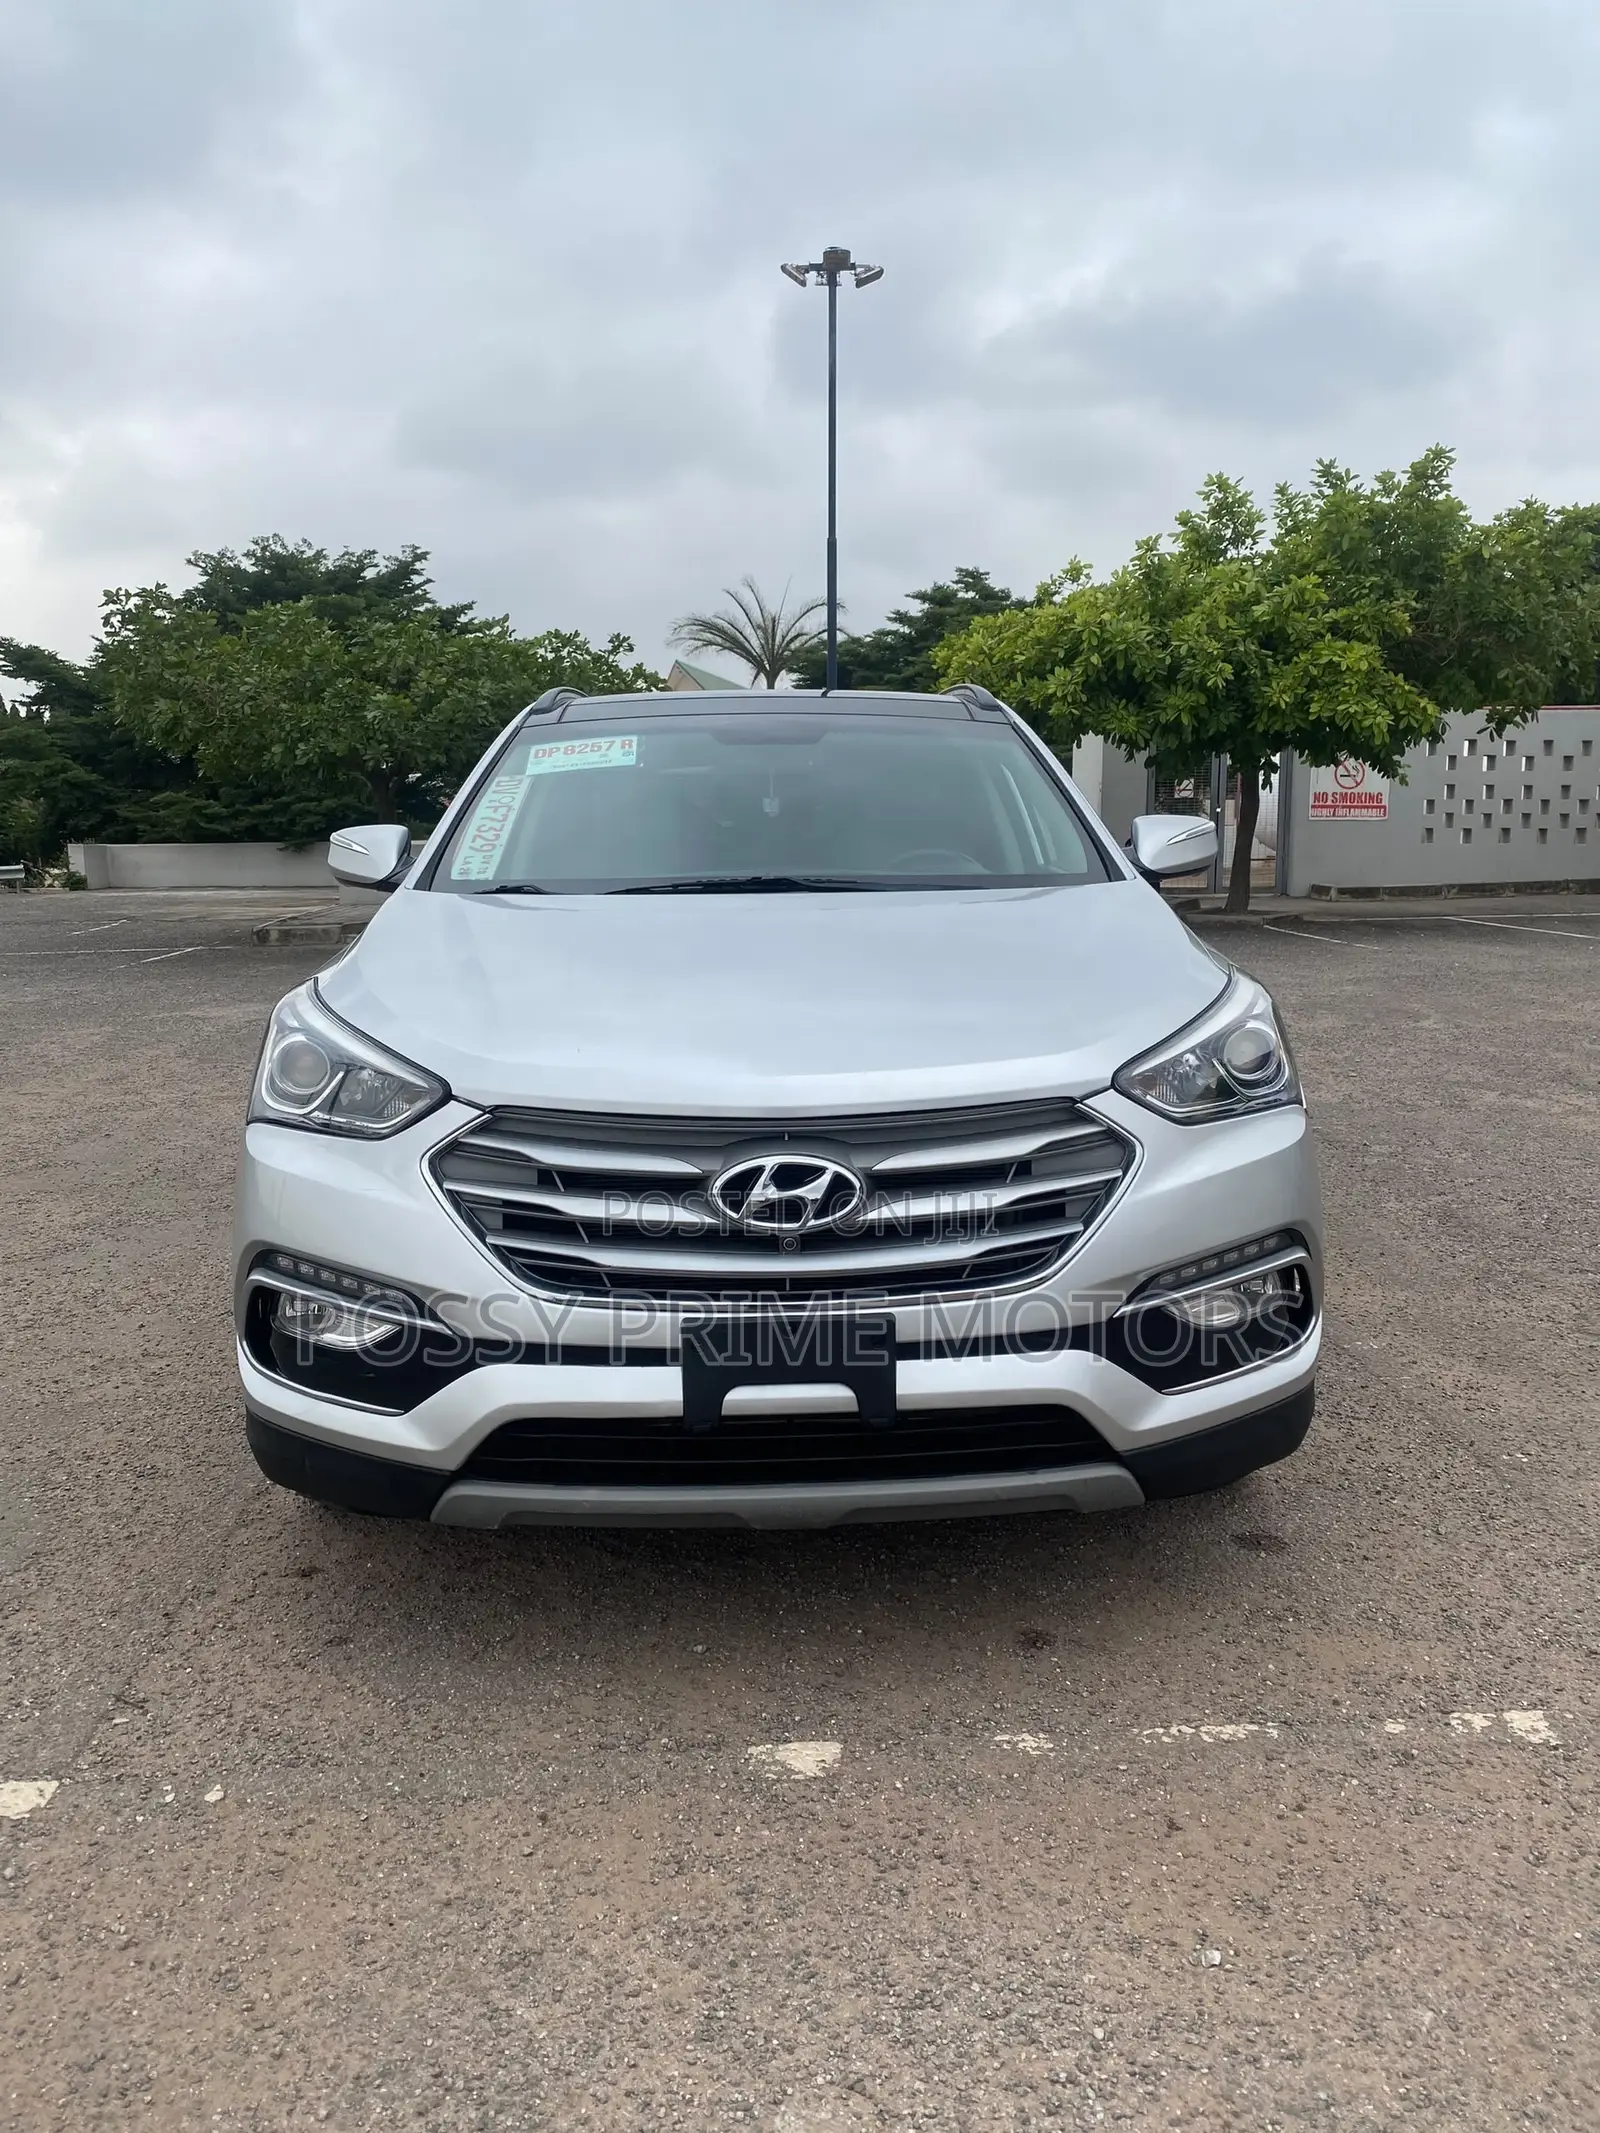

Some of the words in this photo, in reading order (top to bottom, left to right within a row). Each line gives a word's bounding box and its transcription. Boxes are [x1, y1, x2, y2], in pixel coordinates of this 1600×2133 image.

[534, 747, 561, 759] DP
[1313, 792, 1329, 804] NO
[1331, 792, 1383, 805] SMOKING
[1335, 808, 1385, 817] INFLAMMABLE
